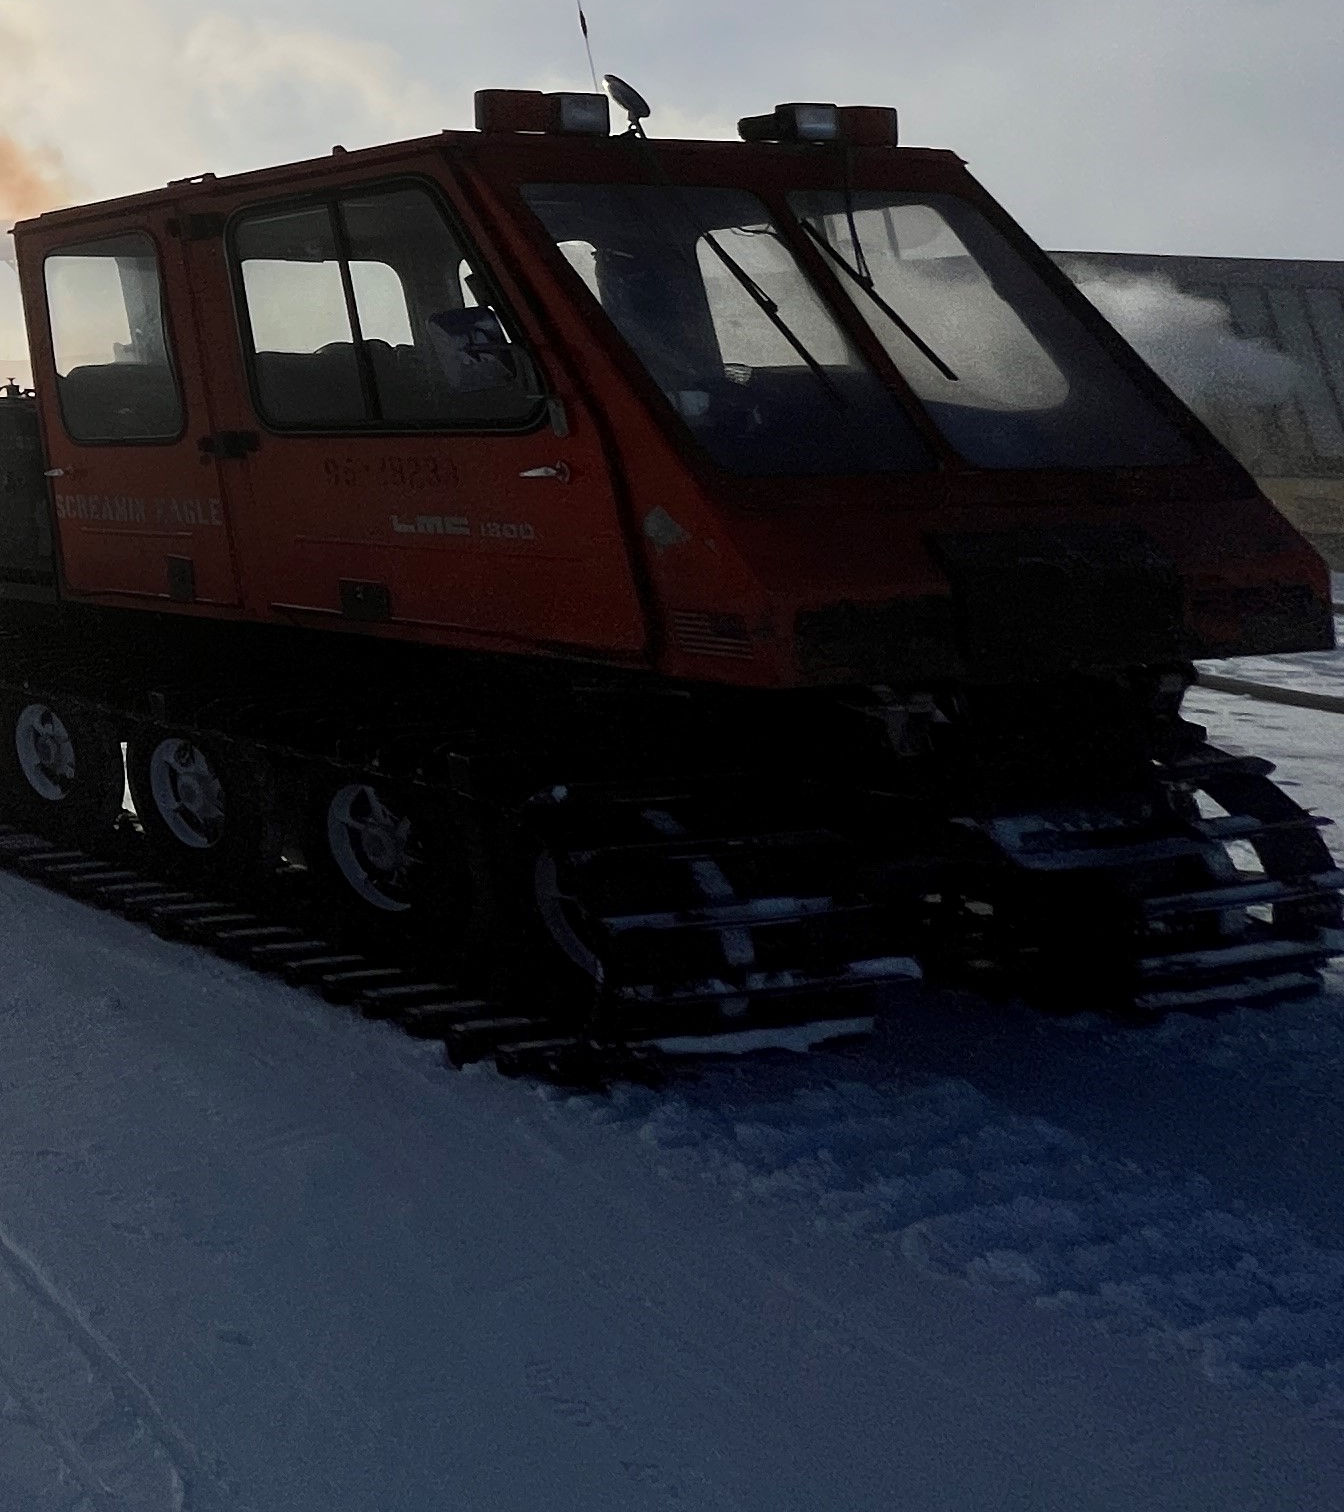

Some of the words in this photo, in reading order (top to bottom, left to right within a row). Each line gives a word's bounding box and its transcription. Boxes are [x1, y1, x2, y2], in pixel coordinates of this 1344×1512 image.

[55, 493, 146, 522] SCREAMIN
[157, 497, 223, 526] EAGLE
[389, 514, 471, 536] LMC
